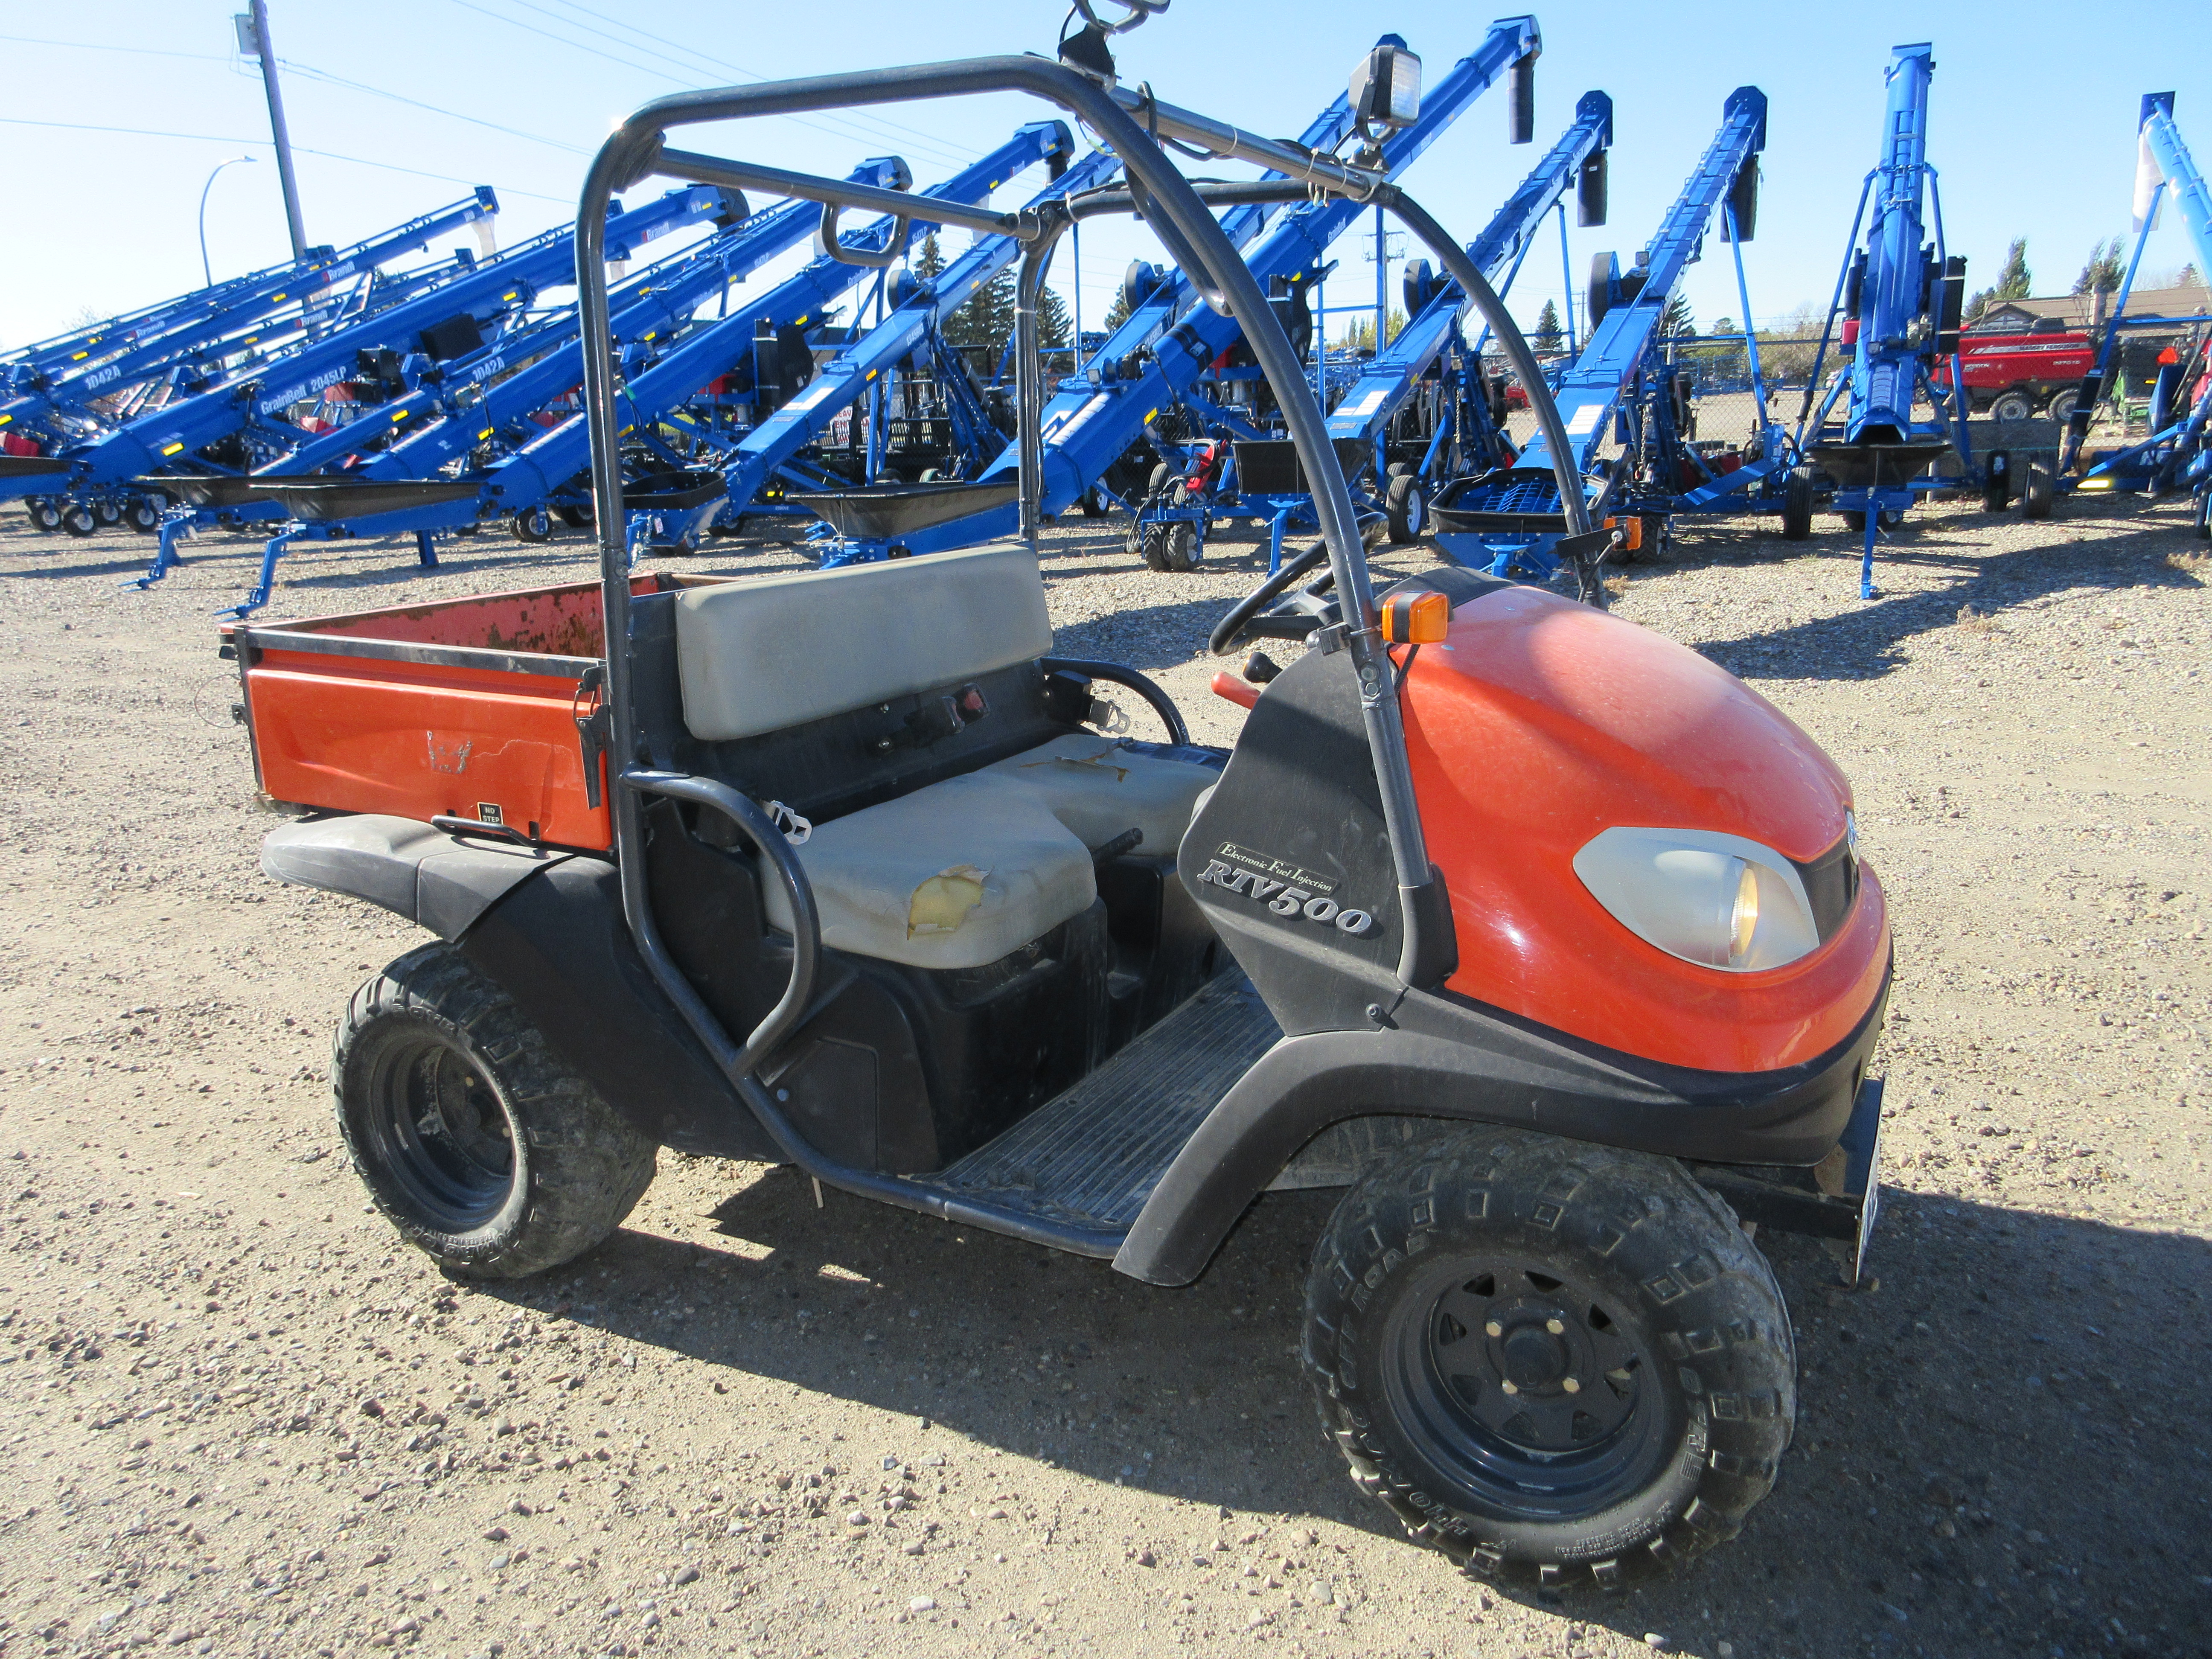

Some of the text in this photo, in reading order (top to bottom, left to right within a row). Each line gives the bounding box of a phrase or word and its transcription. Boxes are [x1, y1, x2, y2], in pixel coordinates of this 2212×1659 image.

[1196, 859, 1372, 932] RTV500
[1220, 844, 1333, 892] Electronic Fuel Injection
[1351, 1231, 1430, 1313] ROAD
